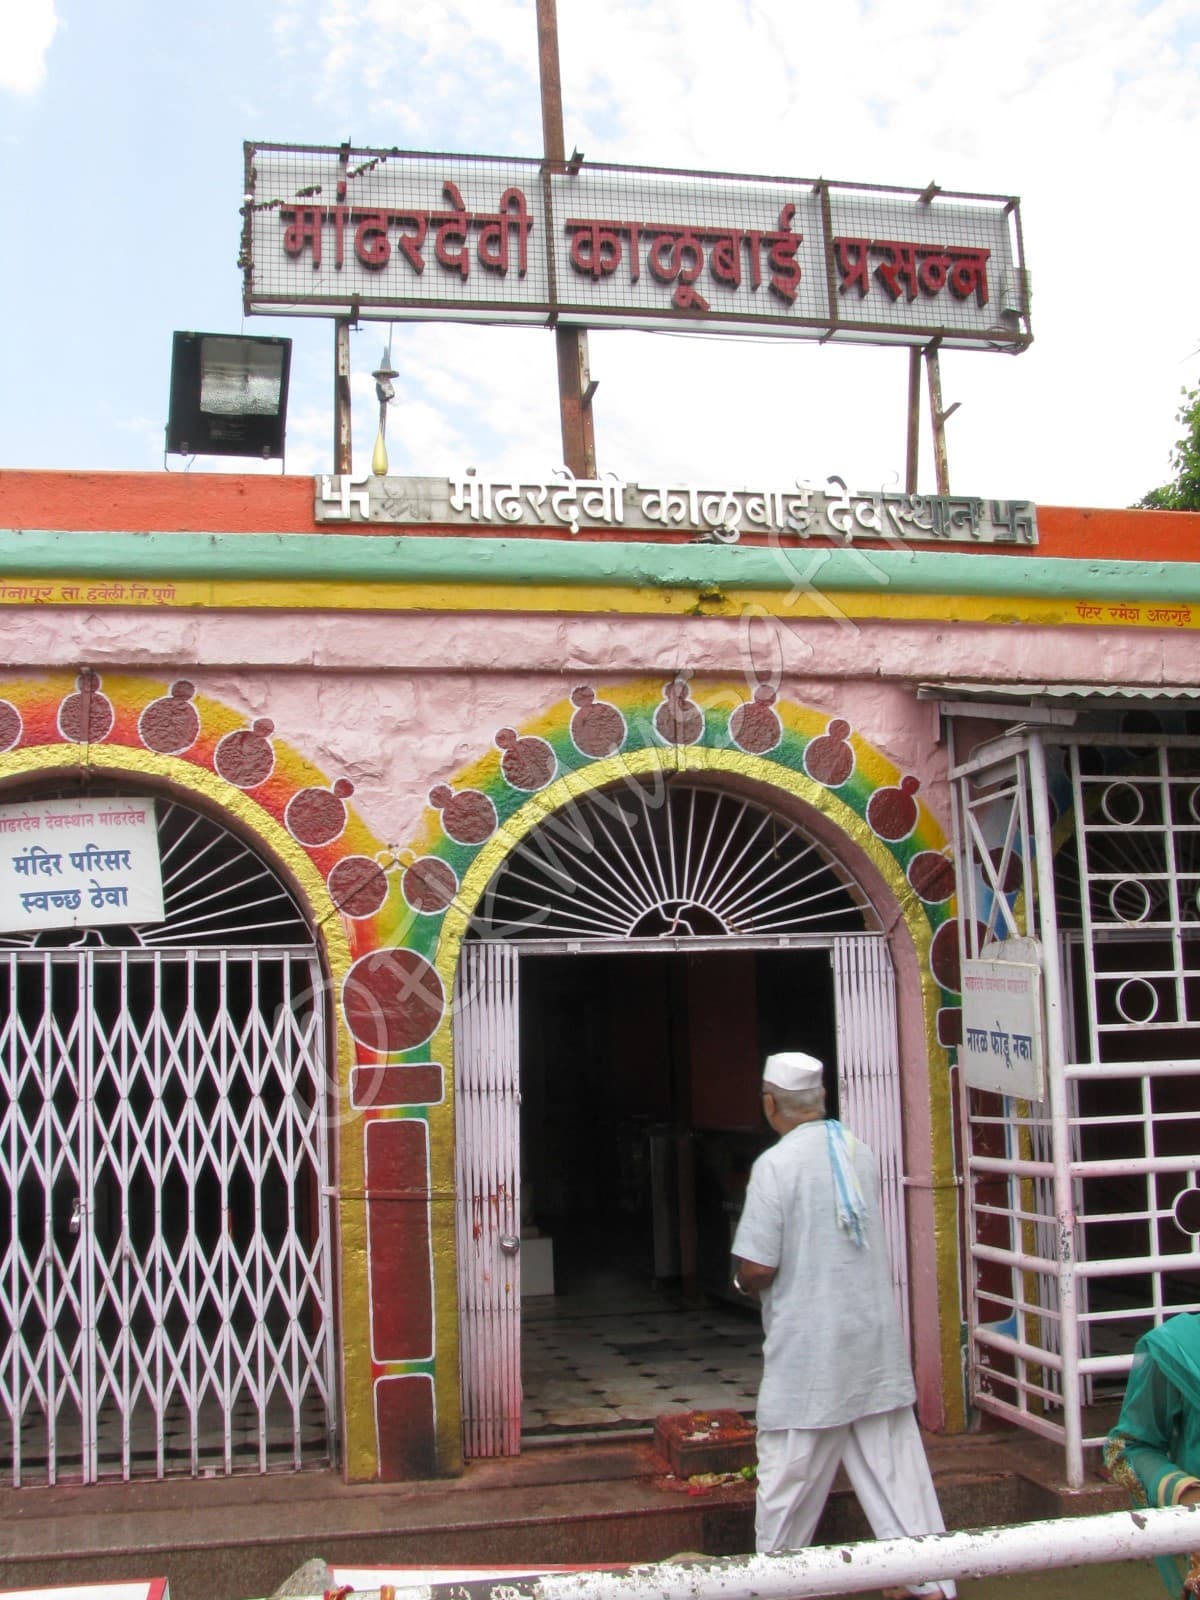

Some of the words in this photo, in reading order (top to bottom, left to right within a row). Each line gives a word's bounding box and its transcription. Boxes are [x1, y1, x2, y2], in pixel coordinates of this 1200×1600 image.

[280, 181, 533, 282] मांढरदेवी
[566, 203, 803, 311] काळूबाई
[833, 236, 991, 309] प्रसन्न
[449, 466, 627, 534] मांढरदेवी
[824, 475, 981, 543] देवस्थान
[152, 584, 176, 604] पुणे
[1108, 603, 1140, 621] रमेश
[0, 811, 41, 833] ांढरदेव
[45, 810, 94, 832] देवस्थान
[98, 806, 146, 826] मांढरदेव
[12, 846, 63, 877] मंदिर
[69, 843, 132, 872] परिसर
[20, 889, 82, 914] स्वच्छ
[88, 879, 128, 908] ठेवा
[966, 1027, 988, 1053] नारळ
[1012, 1034, 1032, 1061] नका
